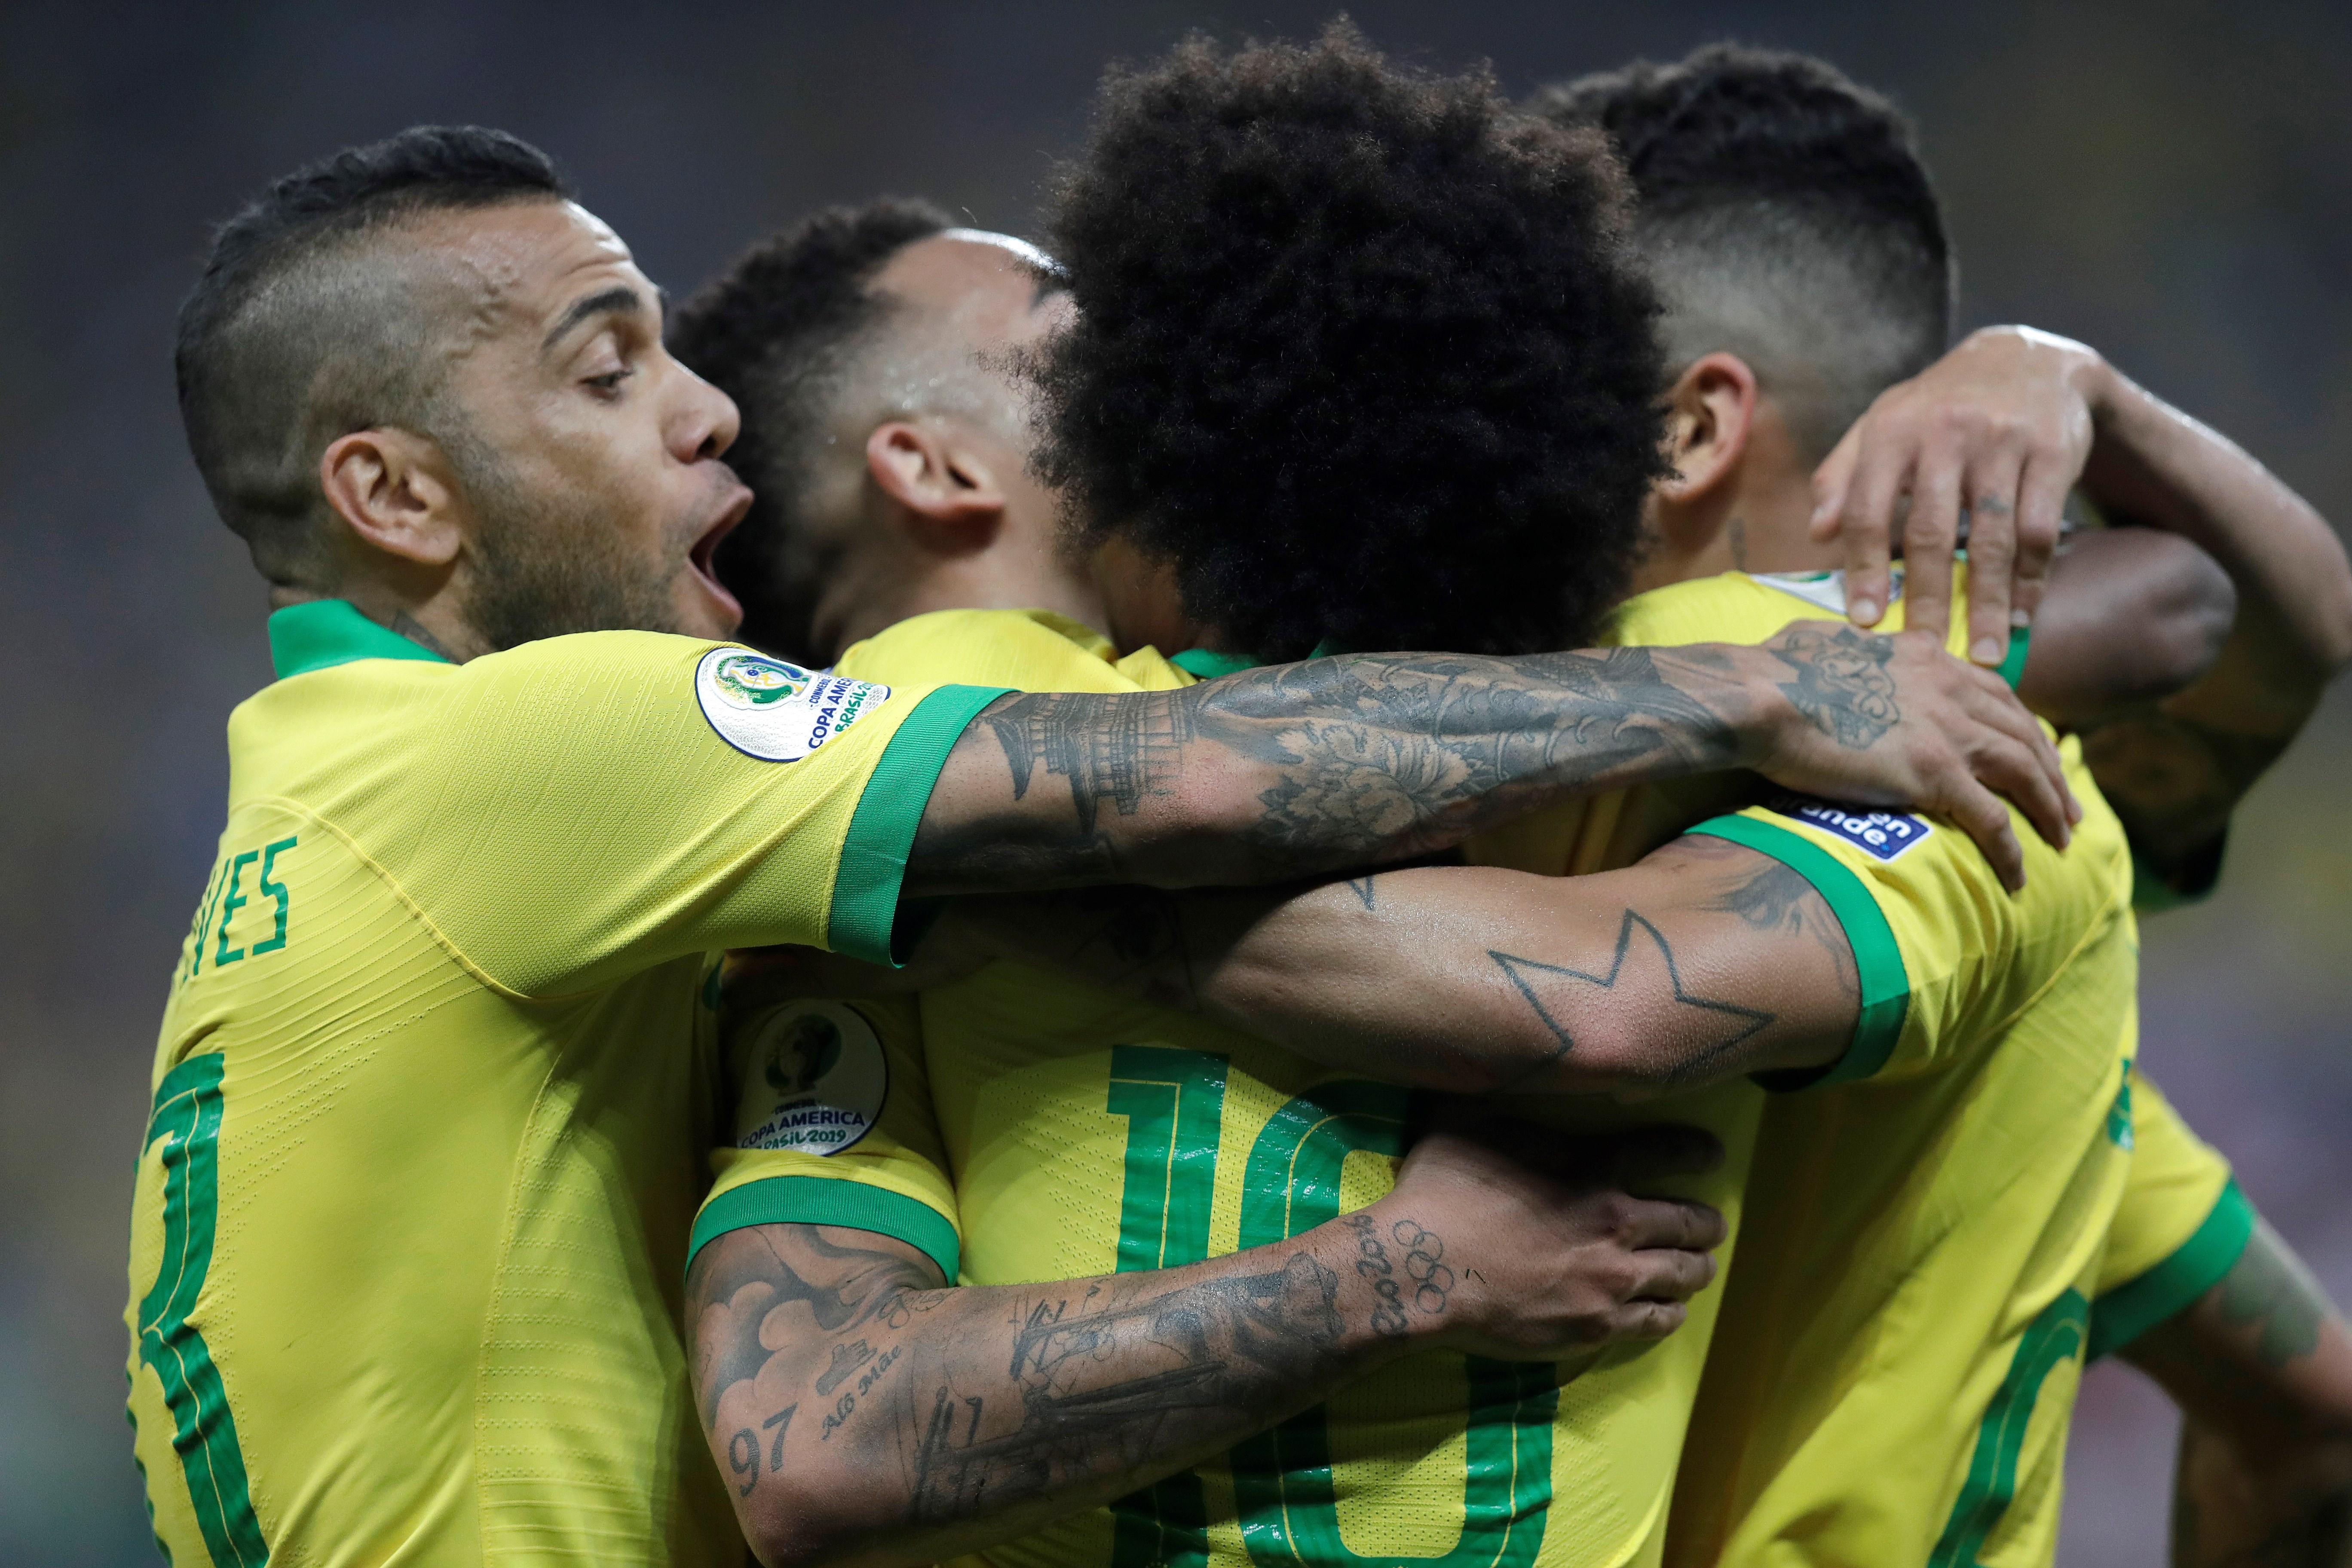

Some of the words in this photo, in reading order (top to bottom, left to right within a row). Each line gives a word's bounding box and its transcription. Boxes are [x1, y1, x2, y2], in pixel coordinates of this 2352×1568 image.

[808, 707, 837, 749] COPA
[827, 677, 857, 705] AMER
[182, 835, 297, 984] VES
[741, 1122, 775, 1148] COPA
[779, 1111, 865, 1130] AMERICA
[807, 1130, 846, 1142] 2019
[1106, 1044, 1559, 1568] 10
[729, 1402, 799, 1498] 97
